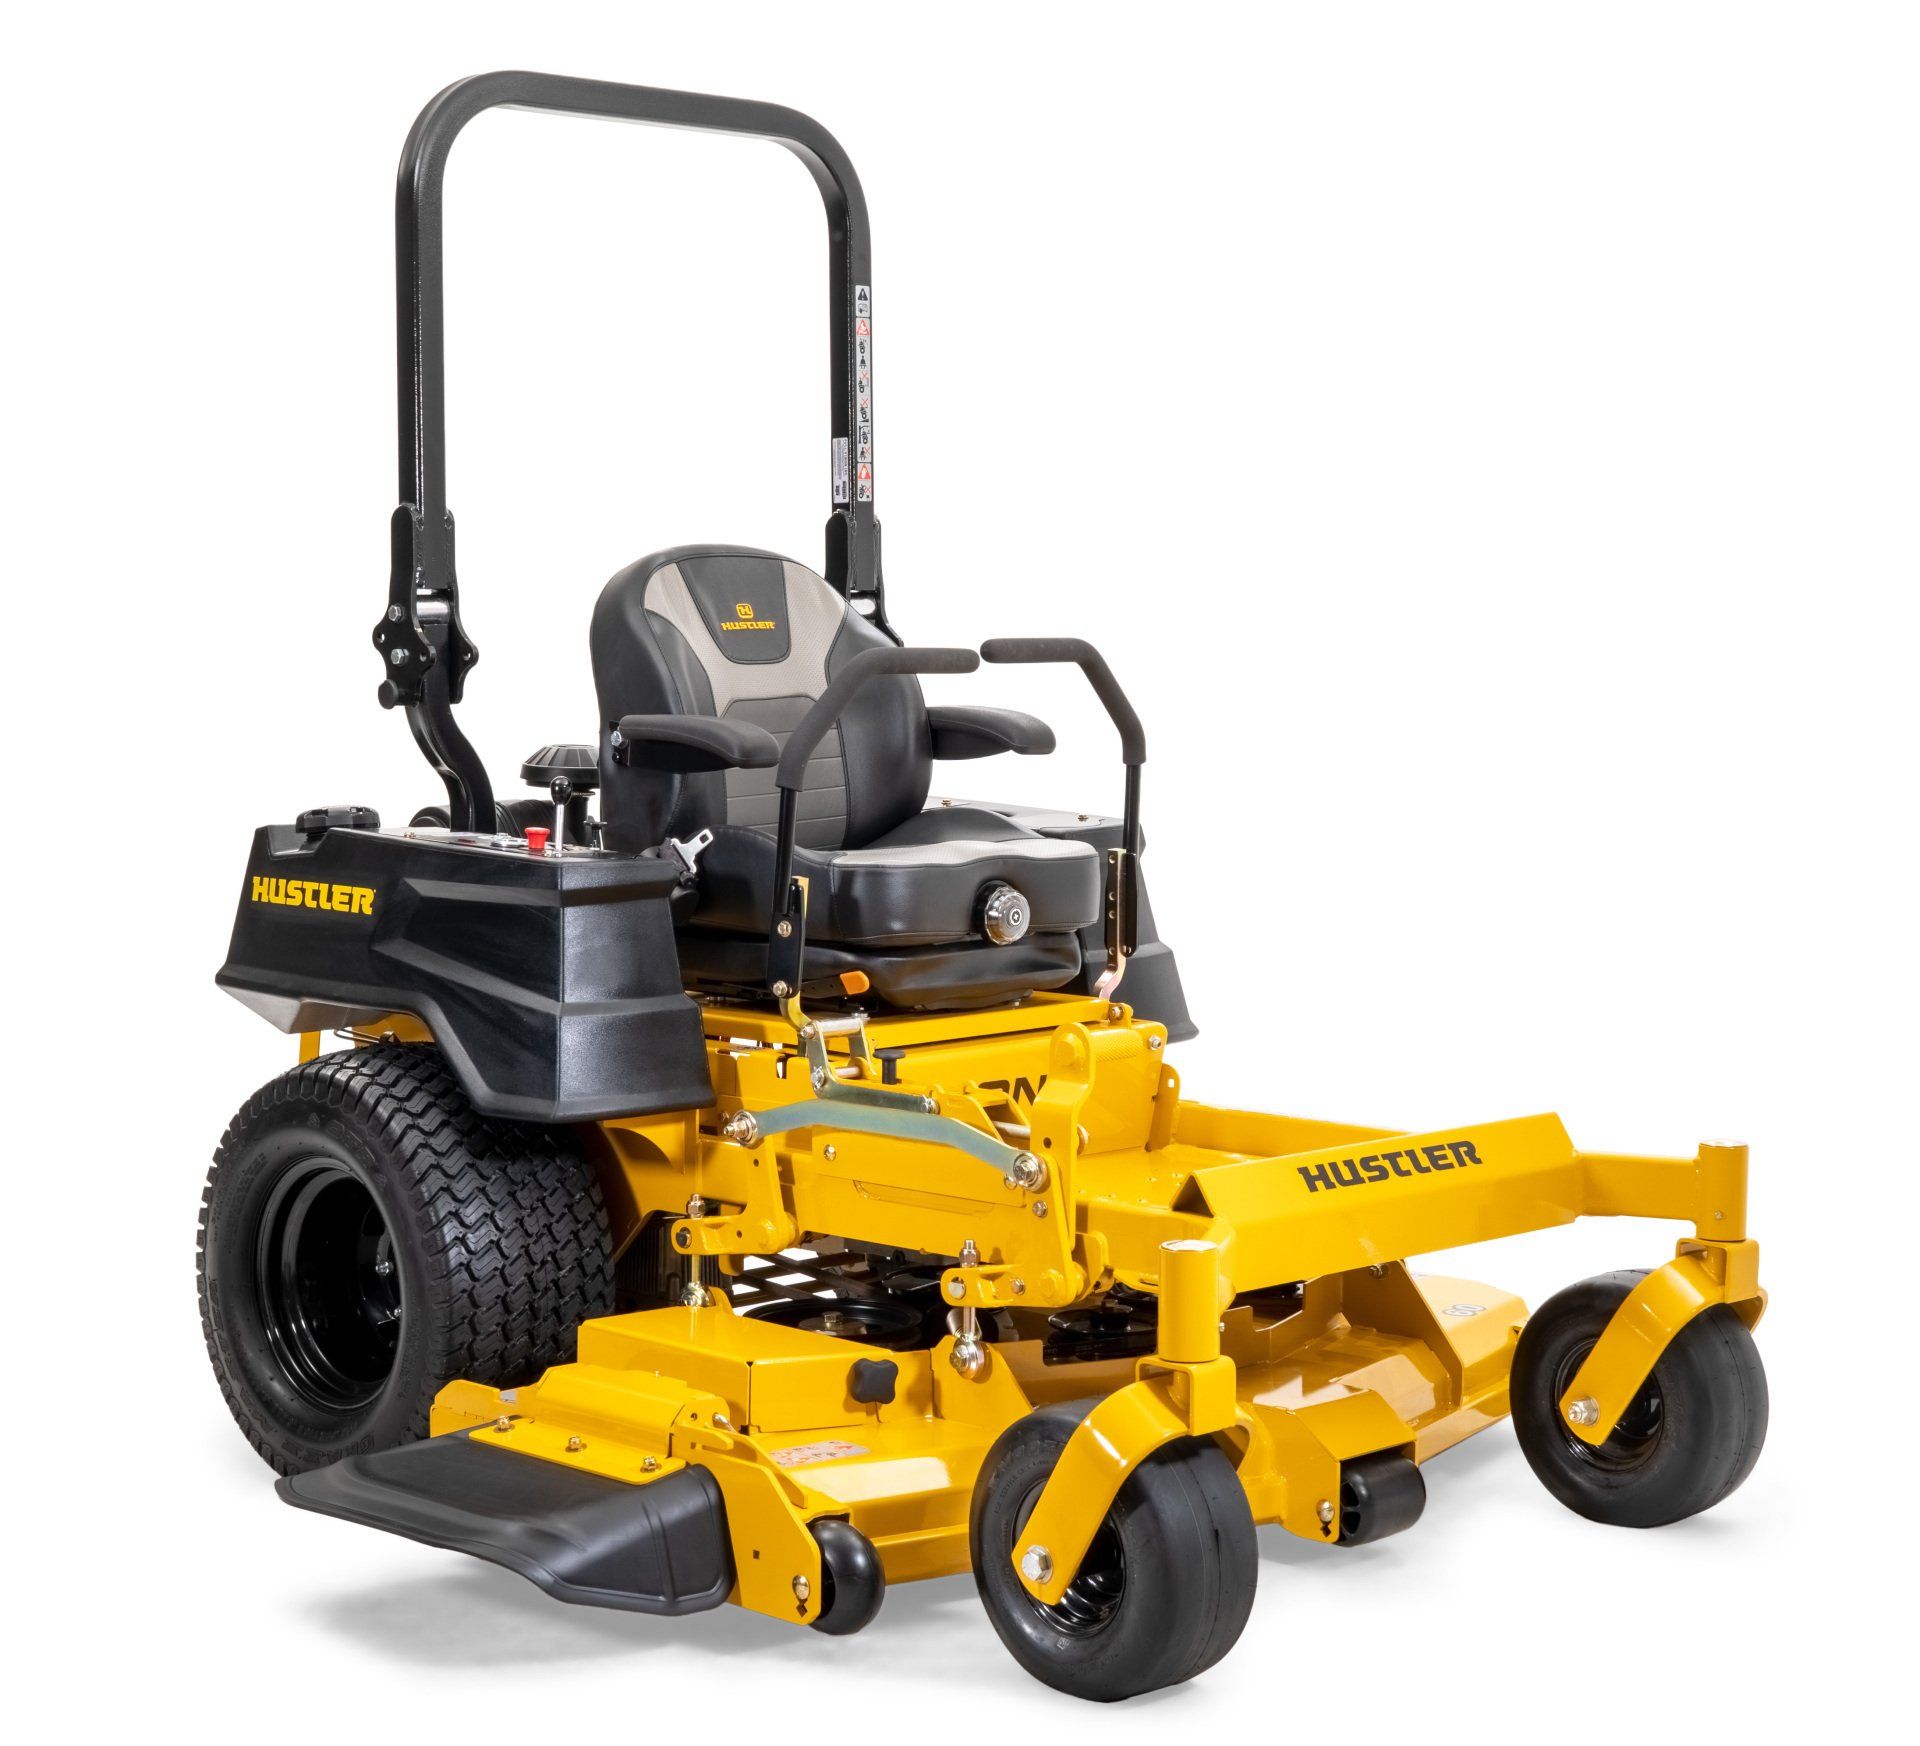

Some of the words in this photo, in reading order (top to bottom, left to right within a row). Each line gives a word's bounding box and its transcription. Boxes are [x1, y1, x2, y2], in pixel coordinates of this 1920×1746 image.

[721, 621, 776, 631] HUSTLER
[251, 876, 375, 916] HUSTLER
[1297, 1140, 1483, 1193] HUSTLER
[1442, 1304, 1487, 1317] 60
